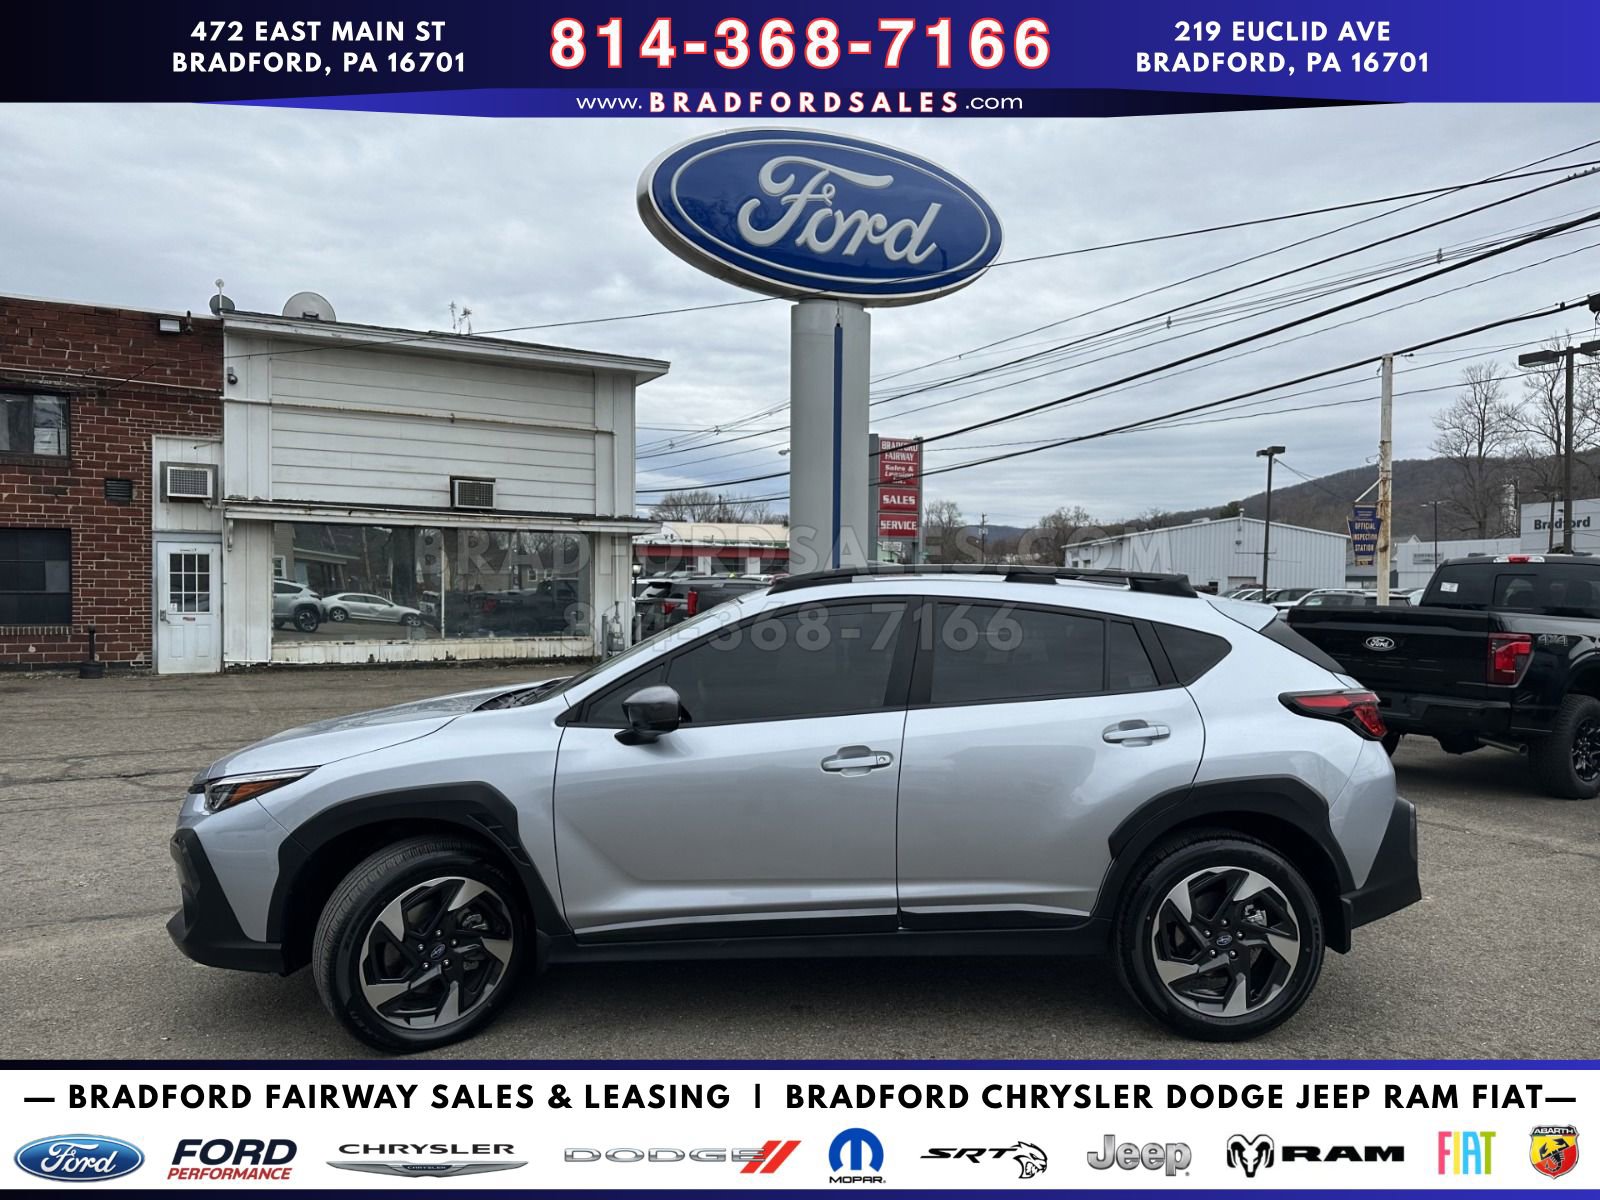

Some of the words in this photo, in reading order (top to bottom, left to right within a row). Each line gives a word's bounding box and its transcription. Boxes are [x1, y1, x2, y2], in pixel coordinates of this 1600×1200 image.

[737, 156, 942, 264] Ford
[885, 452, 915, 461] FAIRWAY
[883, 495, 916, 505] SALES
[880, 520, 917, 531] SERVICE
[1355, 522, 1376, 530] OFFICIAL
[1355, 544, 1374, 552] STATION
